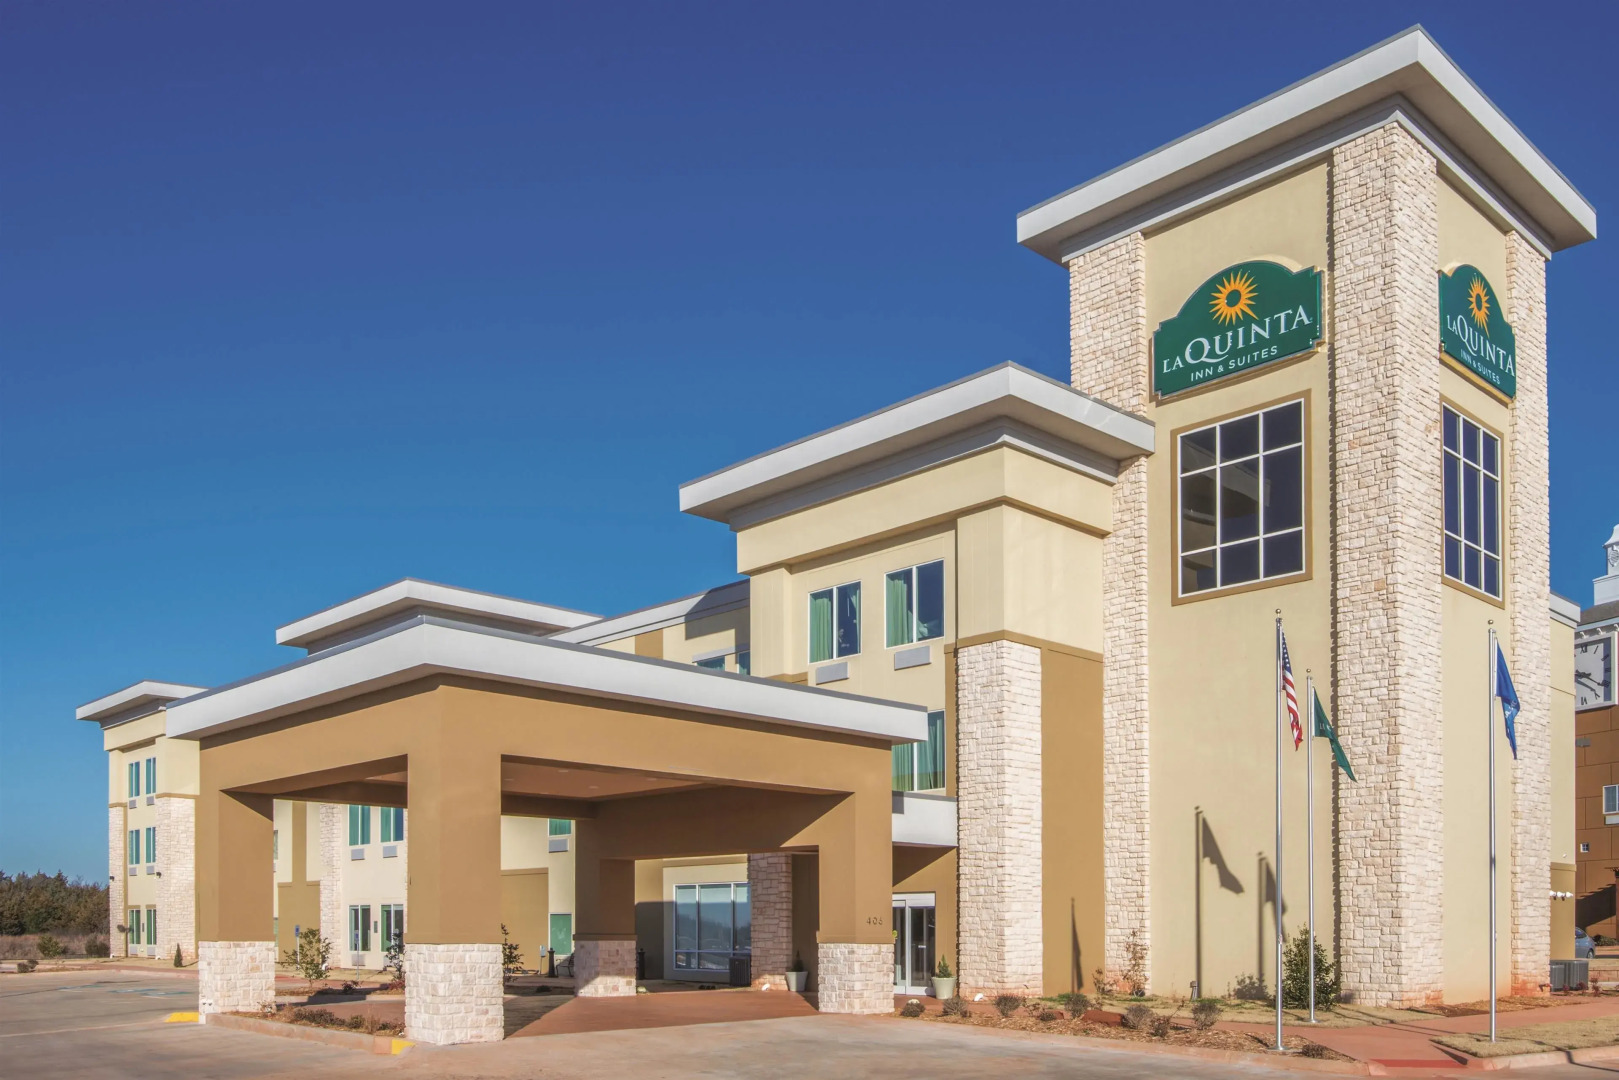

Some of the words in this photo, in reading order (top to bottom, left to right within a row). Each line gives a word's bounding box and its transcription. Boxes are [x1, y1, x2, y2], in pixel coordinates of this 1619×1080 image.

[1184, 304, 1311, 363] QUINTA
[1457, 314, 1515, 377] QUINTA
[1190, 366, 1213, 382] INN
[1217, 365, 1224, 373] &
[1228, 345, 1278, 370] SUITES
[1460, 348, 1472, 365] INN
[1477, 362, 1501, 385] SUITES
[866, 916, 883, 926] 406
